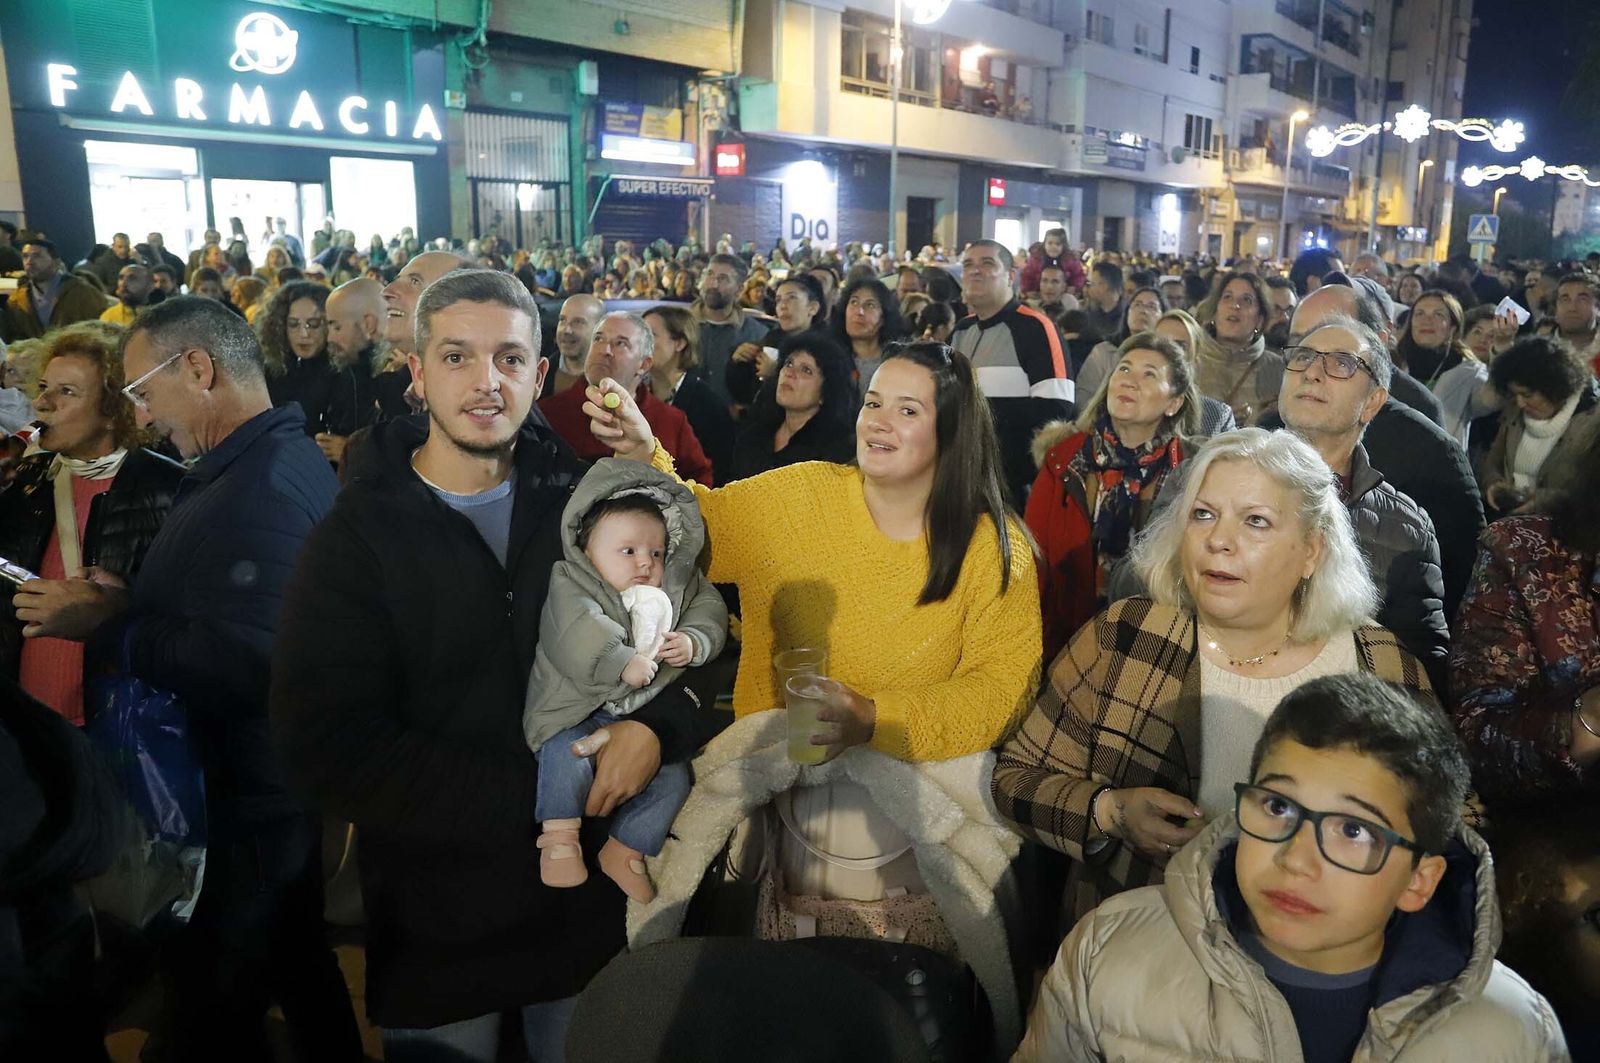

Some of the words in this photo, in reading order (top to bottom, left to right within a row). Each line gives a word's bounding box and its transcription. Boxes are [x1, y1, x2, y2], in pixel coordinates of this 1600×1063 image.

[47, 63, 442, 141] FARMACIA
[618, 180, 658, 194] SUPER
[659, 182, 710, 196] EFECTIVO
